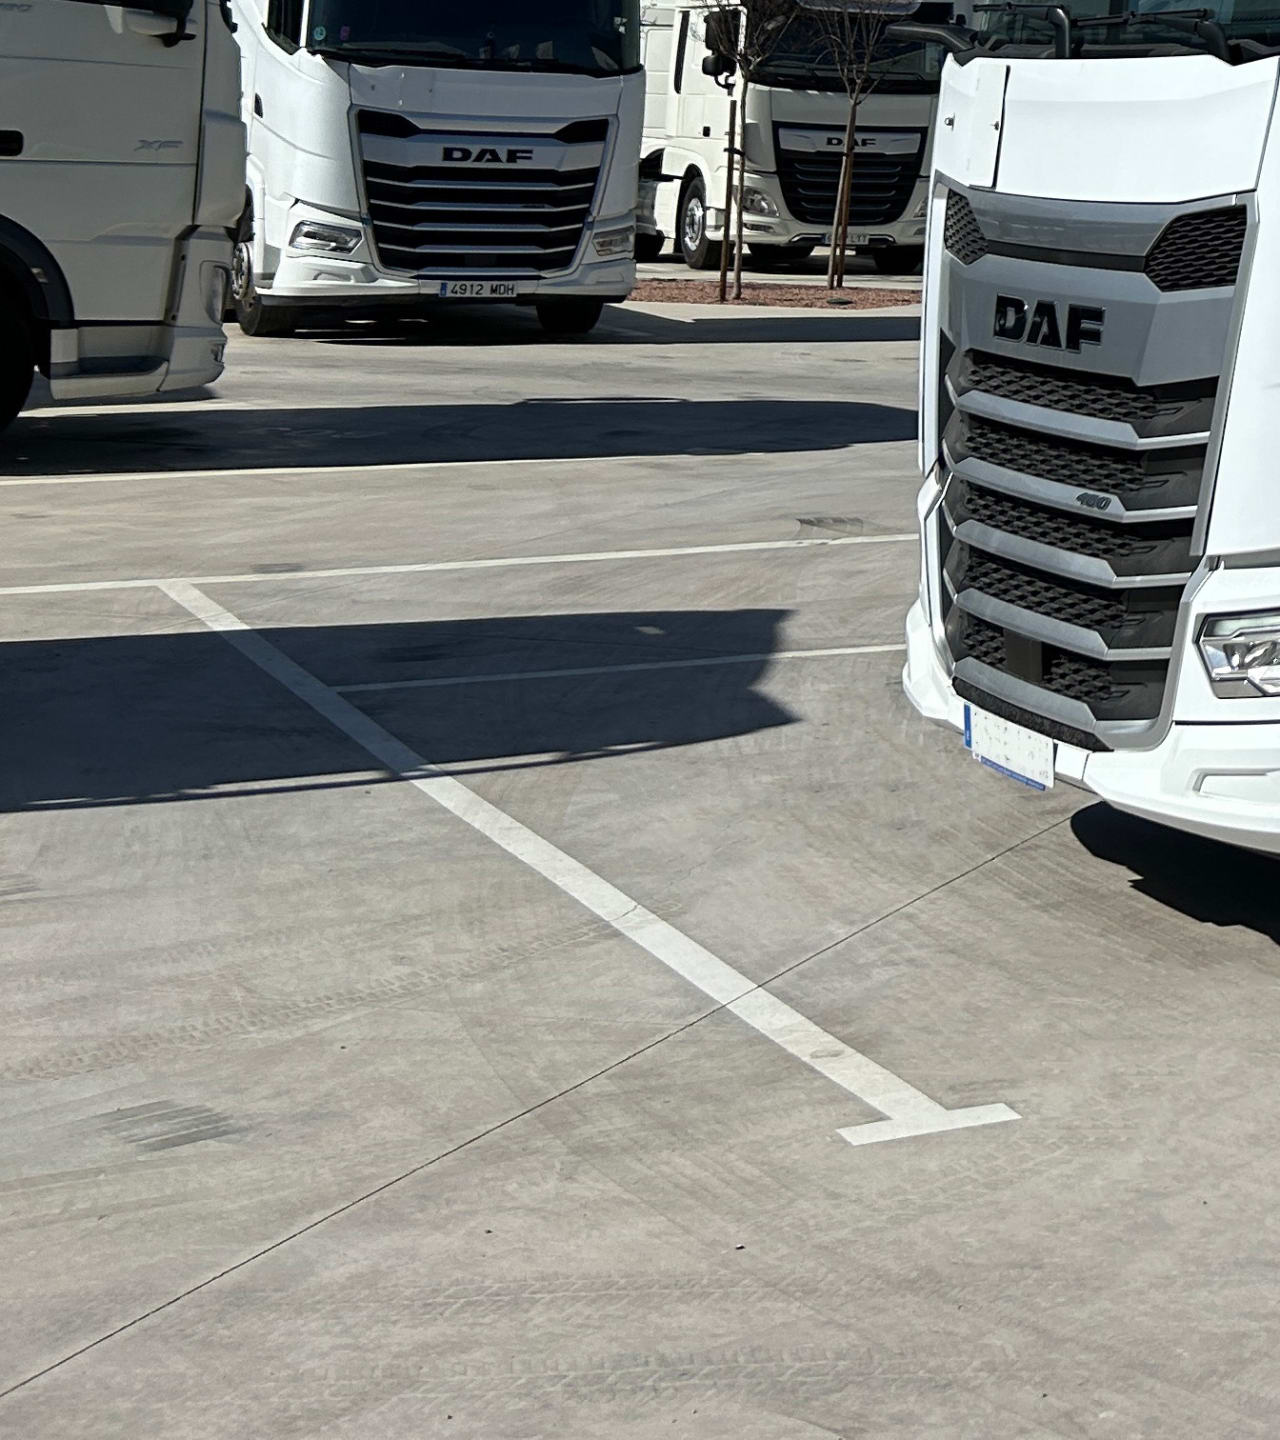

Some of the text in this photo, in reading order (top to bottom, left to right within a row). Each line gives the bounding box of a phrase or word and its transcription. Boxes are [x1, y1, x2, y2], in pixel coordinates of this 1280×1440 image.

[134, 139, 183, 151] XF
[442, 146, 533, 163] DAF
[450, 282, 483, 296] 4912
[994, 292, 1107, 354] DAF
